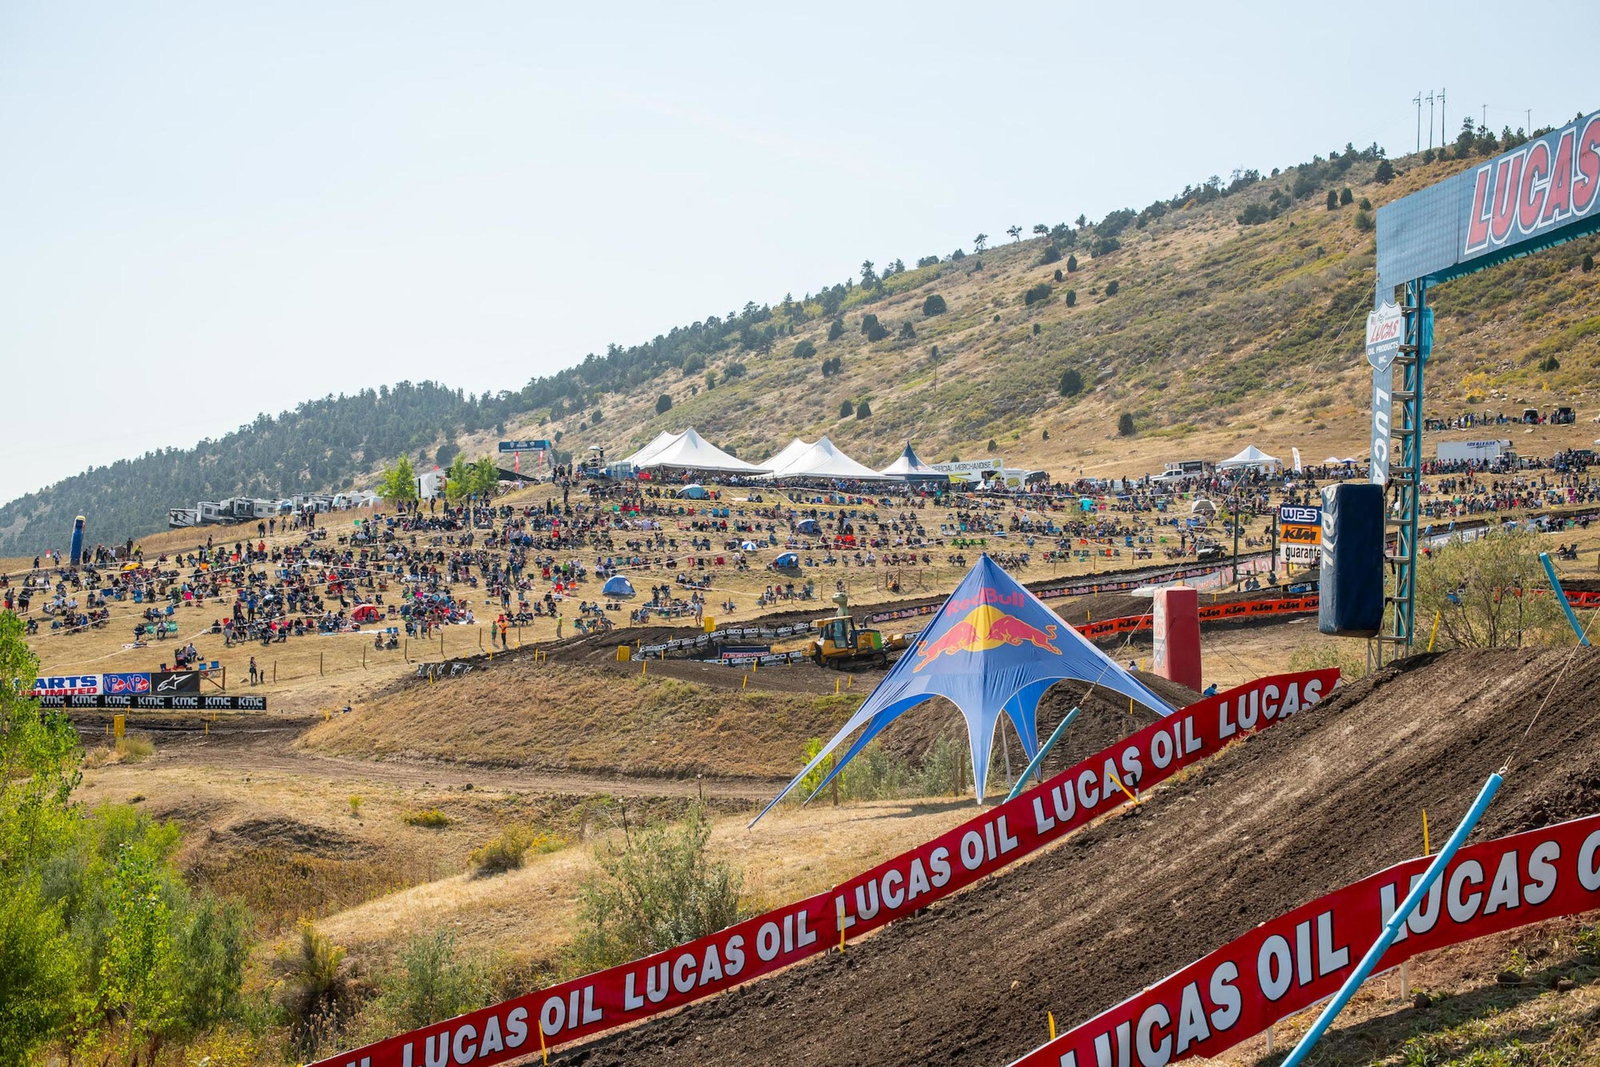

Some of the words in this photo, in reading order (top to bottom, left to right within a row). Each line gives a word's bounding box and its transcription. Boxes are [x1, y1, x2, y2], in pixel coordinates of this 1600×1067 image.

[1464, 112, 1600, 255] LUCAS
[1370, 319, 1399, 343] LUCAS
[1376, 341, 1398, 353] PRODUCTS
[955, 461, 991, 470] MERCHANDISE
[1281, 507, 1317, 522] WPS
[1283, 527, 1317, 541] KTM
[1225, 606, 1245, 615] KTM
[1251, 603, 1273, 612] KTM
[1278, 601, 1300, 610] KTM
[34, 676, 97, 689] ARTS
[72, 696, 97, 704] KMC
[105, 696, 130, 704] KMC
[138, 697, 164, 705] KMC
[172, 697, 198, 705] KMC
[205, 697, 231, 705] KMC
[238, 697, 263, 706] KMC
[402, 1006, 528, 1067] LUCAS
[540, 985, 603, 1036] OIL
[624, 934, 745, 1011] LUCAS
[756, 910, 817, 961] OIL
[835, 847, 951, 932] LUCAS
[960, 815, 1018, 871] OIL
[1032, 745, 1143, 835] LUCAS
[1151, 715, 1202, 769] OIL
[1218, 679, 1322, 739] LUCAS
[1060, 961, 1242, 1067] UCAS
[1257, 910, 1349, 1000] OIL
[1379, 840, 1560, 945] LUCAS
